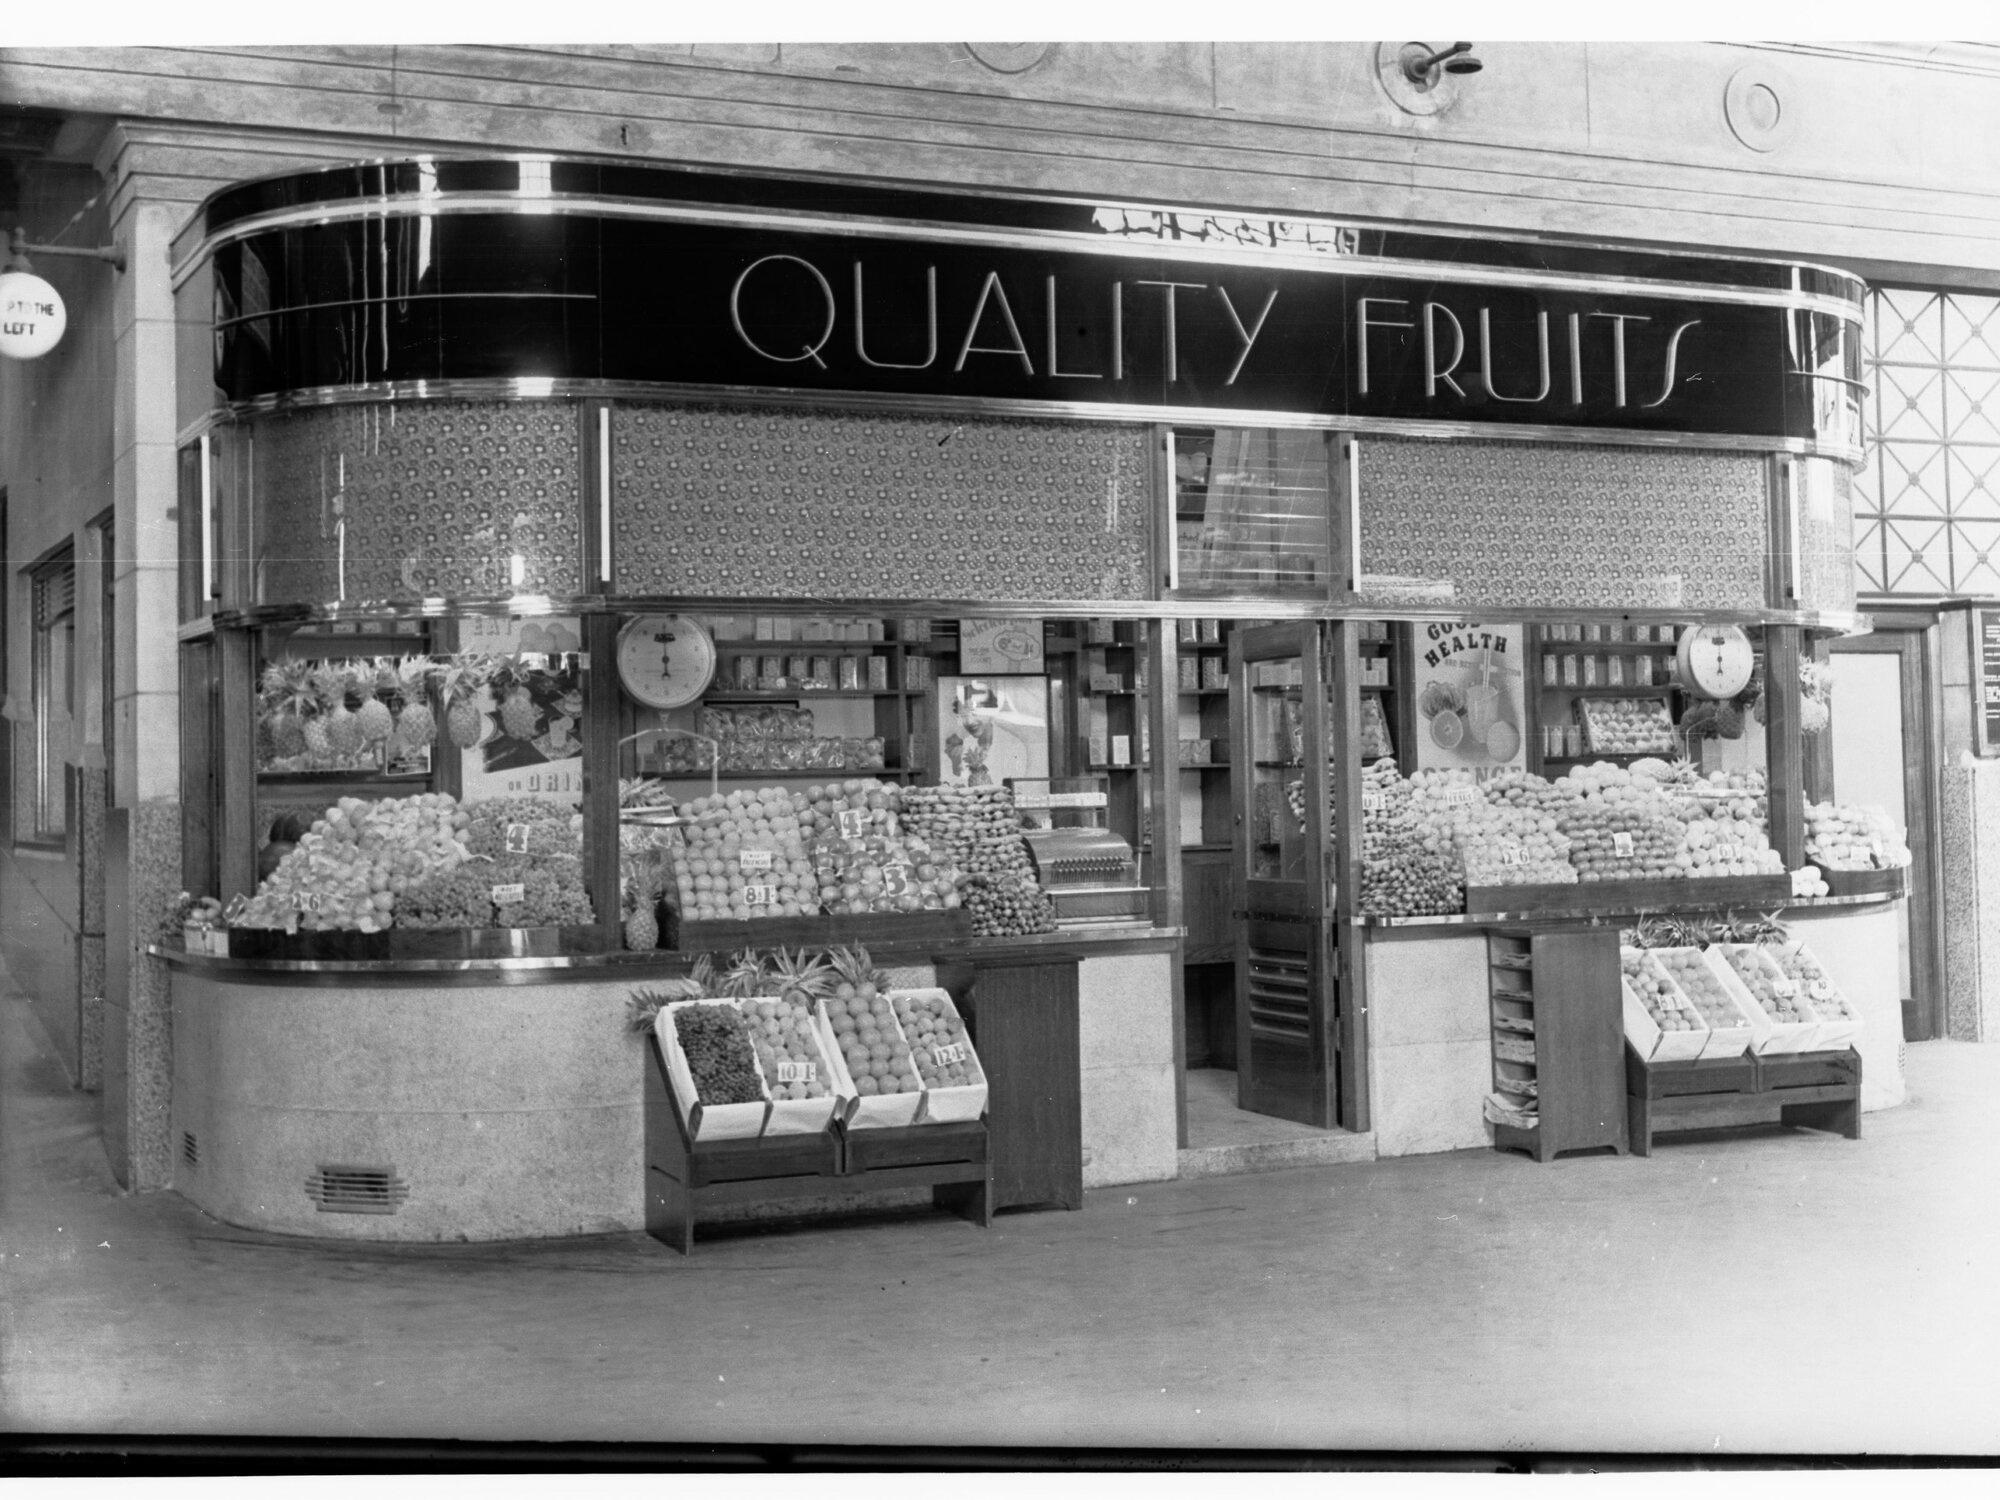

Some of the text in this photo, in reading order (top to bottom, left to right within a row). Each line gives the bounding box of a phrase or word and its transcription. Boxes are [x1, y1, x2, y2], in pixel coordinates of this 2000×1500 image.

[34, 302, 55, 316] THE
[3, 322, 36, 336] LEFT
[731, 254, 1702, 408] QUALITY FRUITS
[1427, 622, 1481, 640] GO
[1424, 632, 1508, 668] HEALTH
[843, 812, 860, 835] 4
[508, 825, 526, 851] 4
[884, 868, 906, 895] 3
